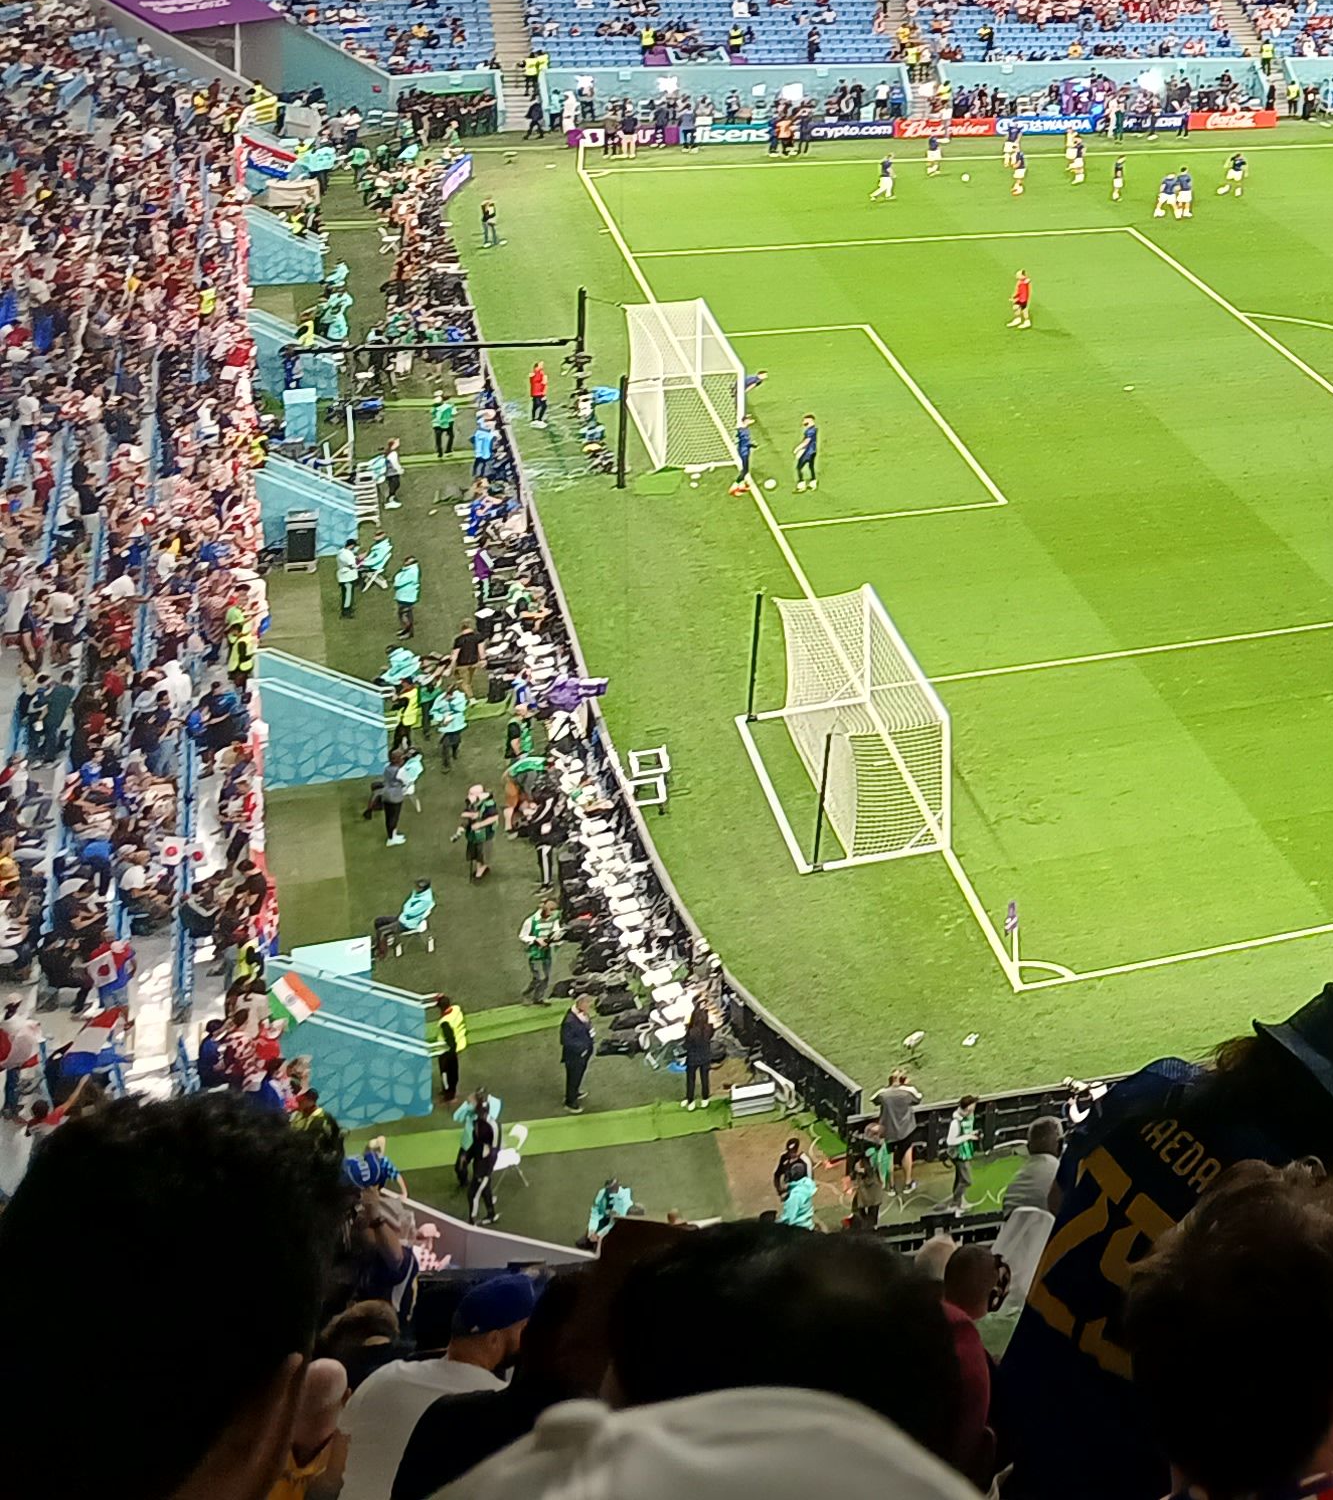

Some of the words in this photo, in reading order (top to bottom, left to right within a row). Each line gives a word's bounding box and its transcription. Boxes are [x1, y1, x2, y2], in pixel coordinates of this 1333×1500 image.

[696, 124, 769, 143] Hisens
[810, 121, 893, 139] crypto.com
[900, 119, 990, 138] Budeiser
[1140, 1118, 1222, 1194] AEDA
